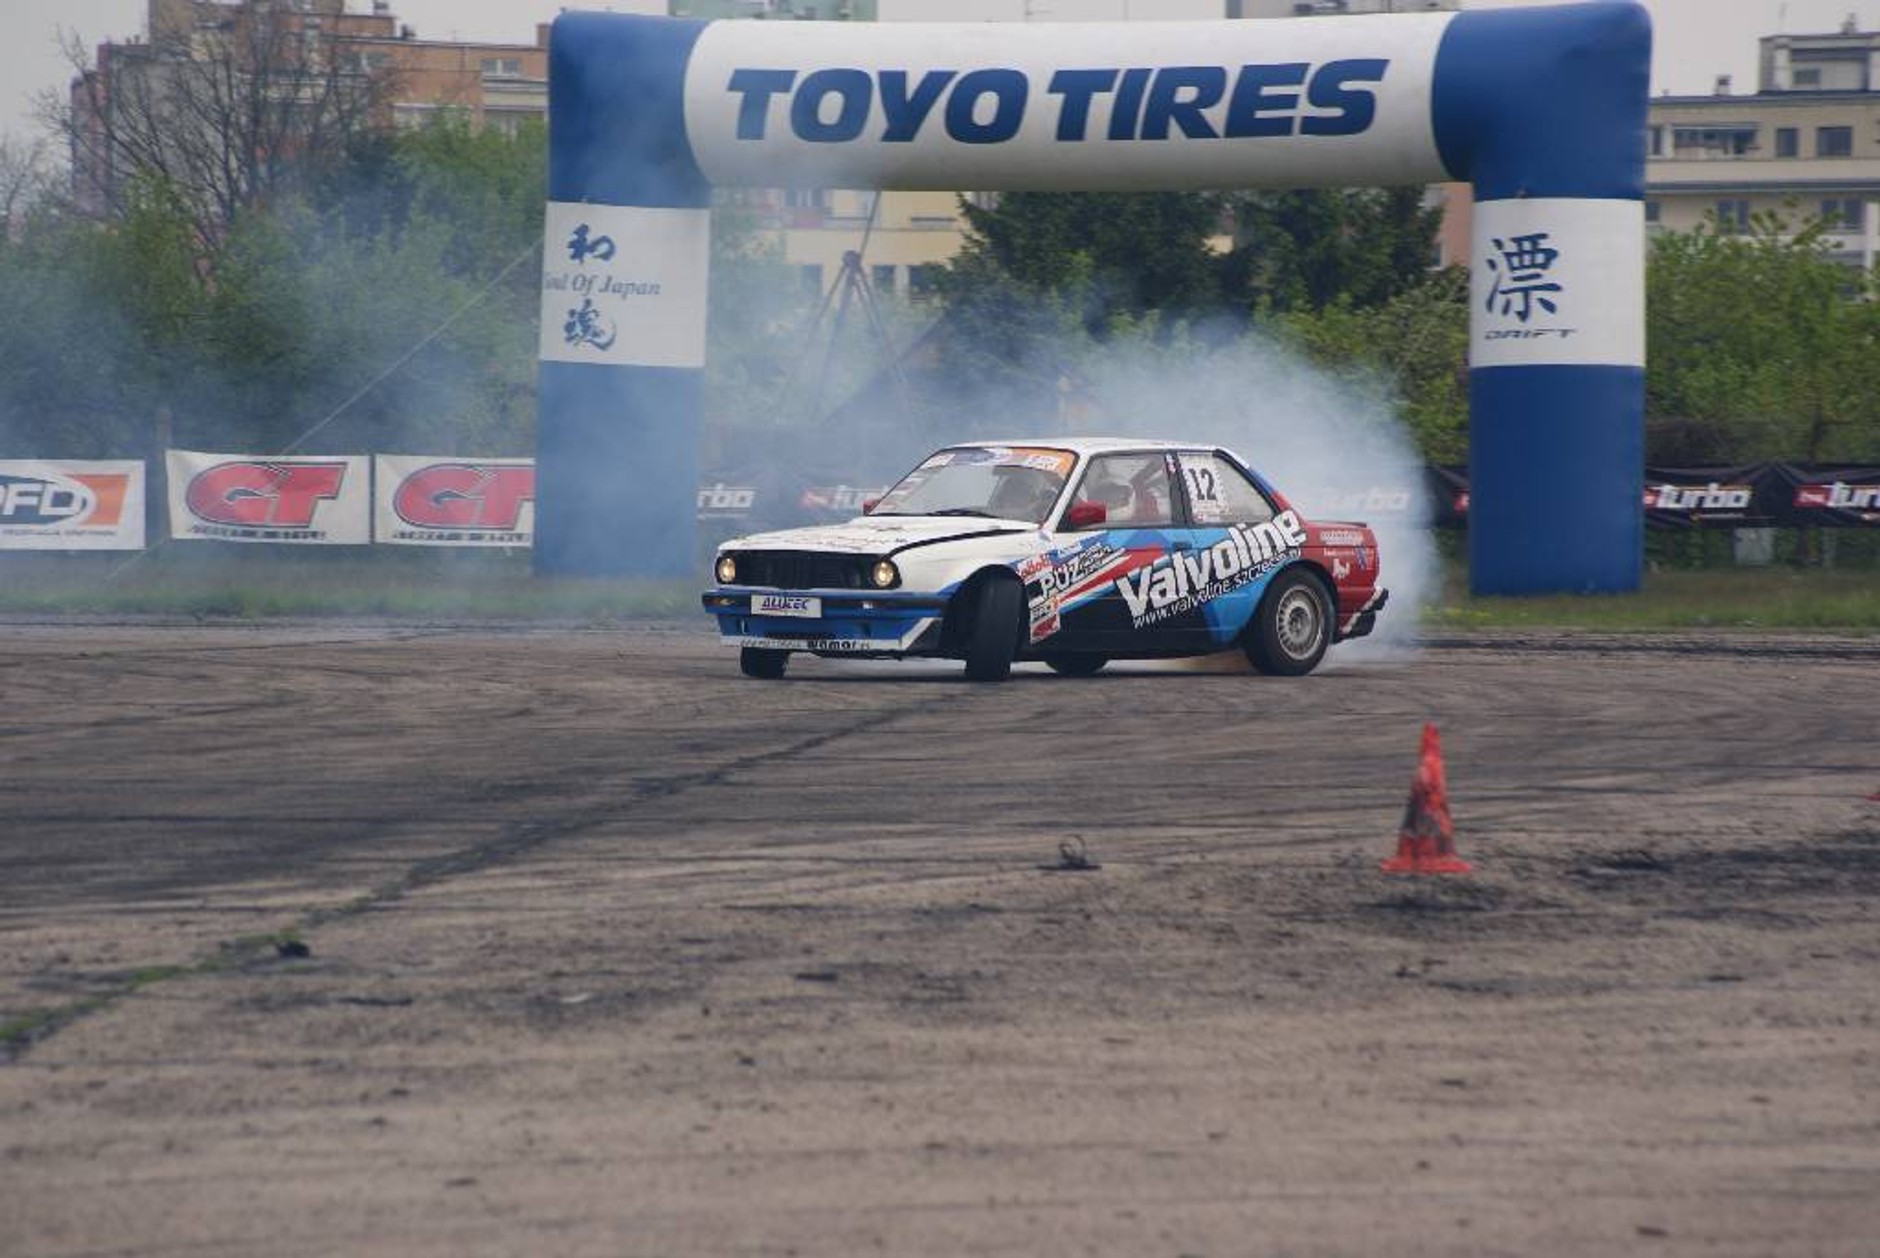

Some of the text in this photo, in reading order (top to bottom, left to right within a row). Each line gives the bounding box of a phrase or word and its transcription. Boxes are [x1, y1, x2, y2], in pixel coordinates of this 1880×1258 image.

[726, 59, 1390, 144] TOYO TIRES
[598, 275, 661, 300] Japan
[1485, 233, 1563, 322] 漂
[1484, 328, 1577, 340] DRIFT
[0, 483, 83, 516] FD
[186, 461, 348, 527] GT
[697, 483, 756, 510] rbo
[1188, 468, 1218, 501] 12
[1656, 482, 1751, 508] turbo
[1827, 481, 1880, 508] tur
[1116, 509, 1307, 618] Valvoline
